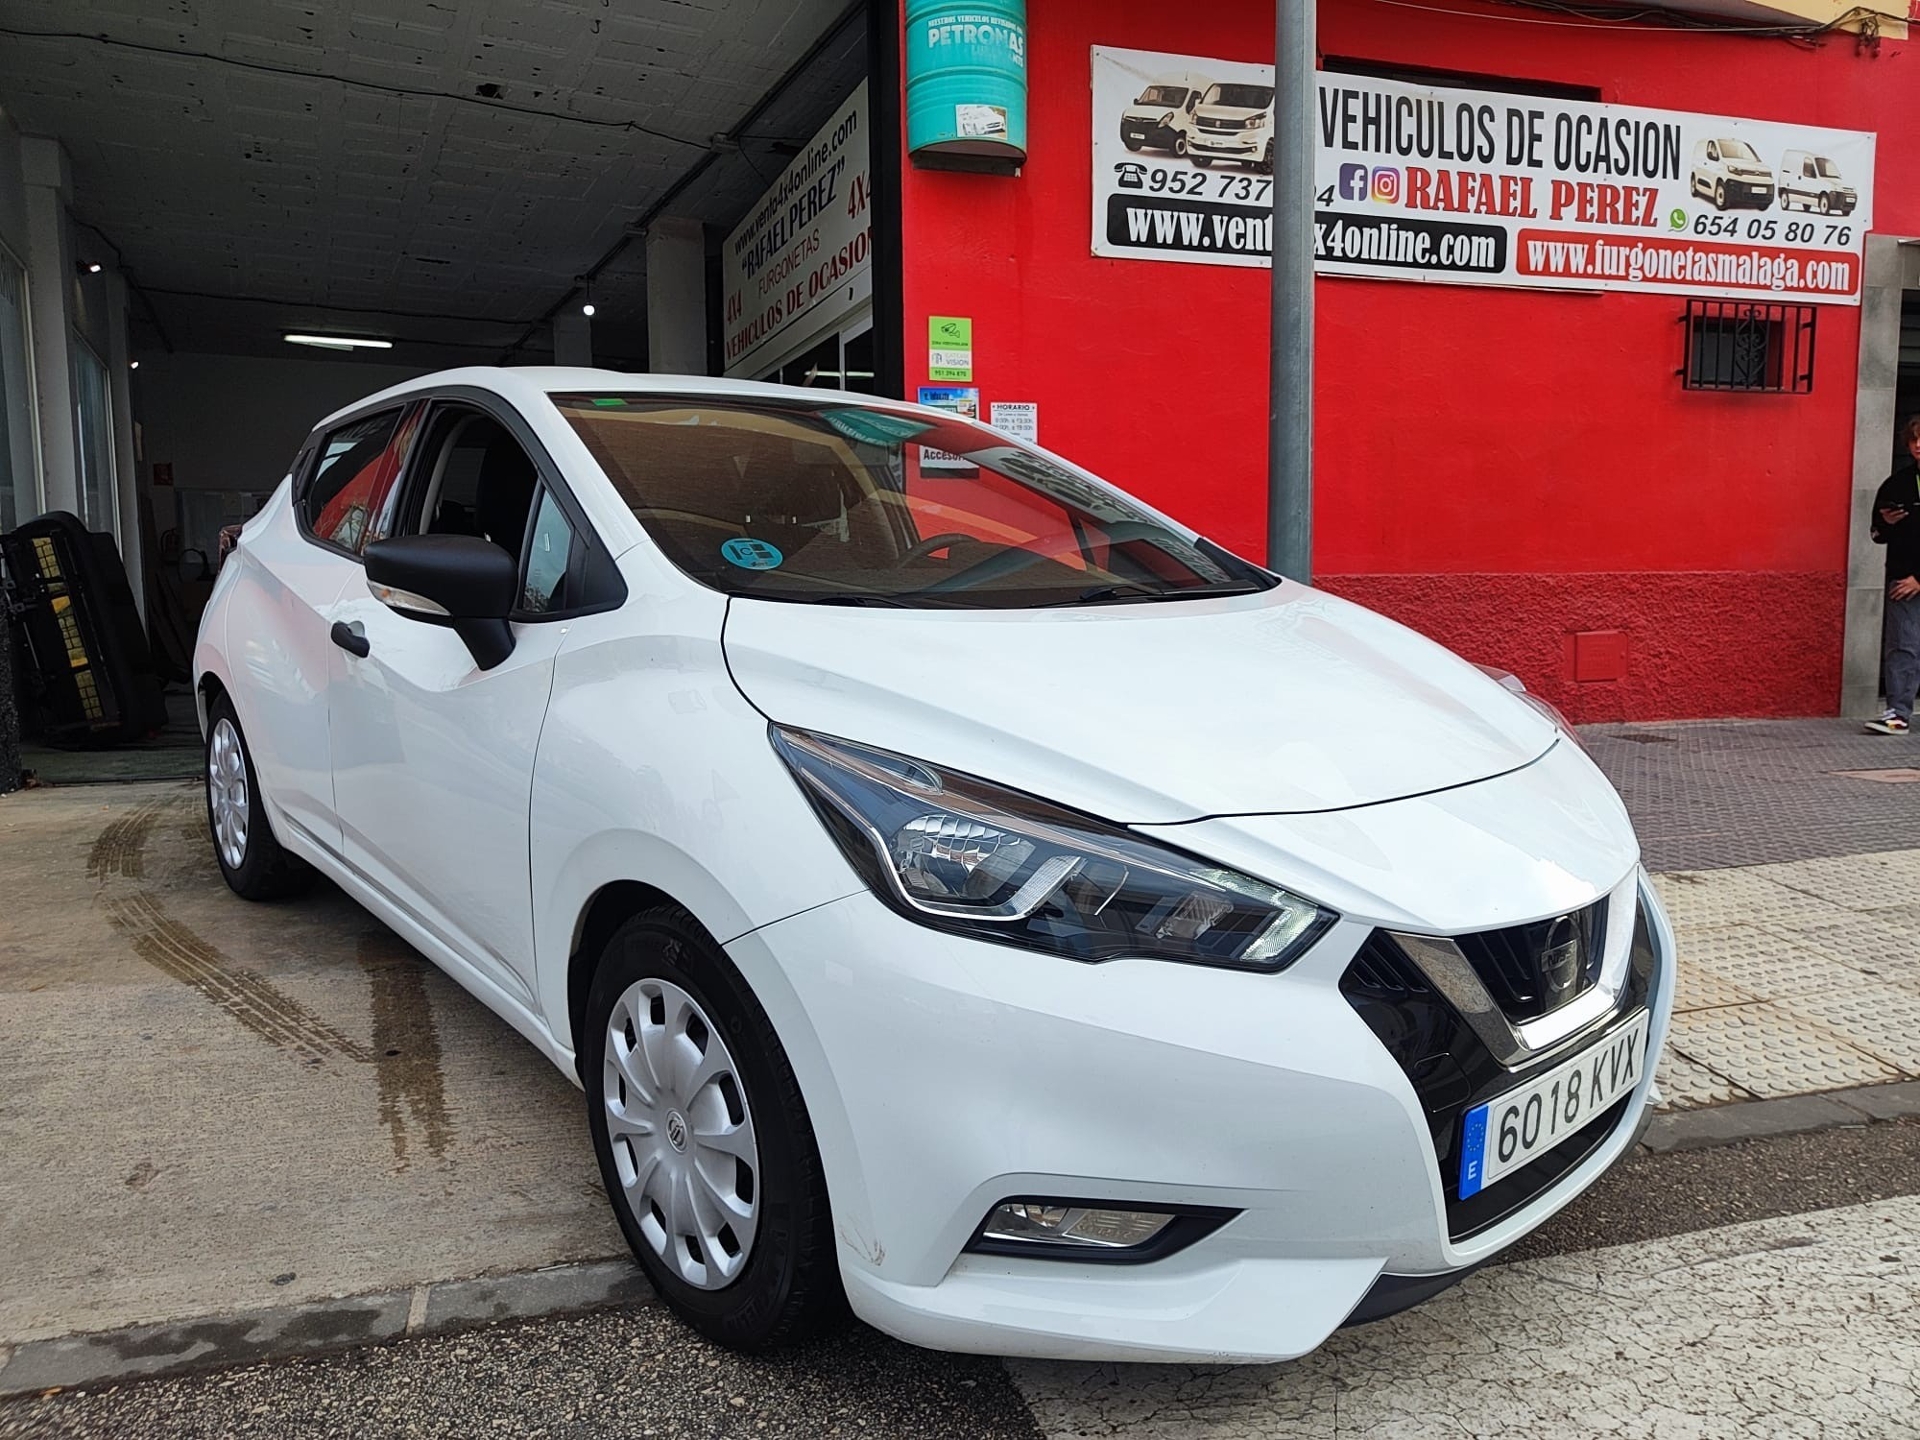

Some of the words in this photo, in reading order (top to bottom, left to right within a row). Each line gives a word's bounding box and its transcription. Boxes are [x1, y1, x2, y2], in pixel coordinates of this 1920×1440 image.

[927, 24, 1024, 56] PETRONAS
[1318, 86, 1496, 165] VEHICULOS
[1505, 107, 1545, 168] DE
[1554, 111, 1681, 180] OCASION
[734, 110, 857, 256] www.vento4x4online.com
[1148, 169, 1208, 197] 952
[1217, 174, 1273, 202] 737
[1404, 166, 1537, 219] RAFAEL
[1549, 179, 1659, 228] PEREZ
[1126, 207, 1496, 269] www.ventx4online.com
[1693, 214, 1738, 238] 654
[1746, 218, 1777, 241] 05
[1784, 221, 1814, 244] 80
[1823, 224, 1851, 246] 76
[758, 228, 820, 296] FURGONETAS
[1527, 238, 1850, 291] www.furgonetasmalaga.com
[726, 302, 783, 360] VEHICULOS
[786, 284, 805, 316] DE
[727, 290, 743, 326] 4X4
[1498, 1069, 1583, 1164] 6018
[1589, 1027, 1640, 1109] KVX
[1467, 1160, 1478, 1181] E
